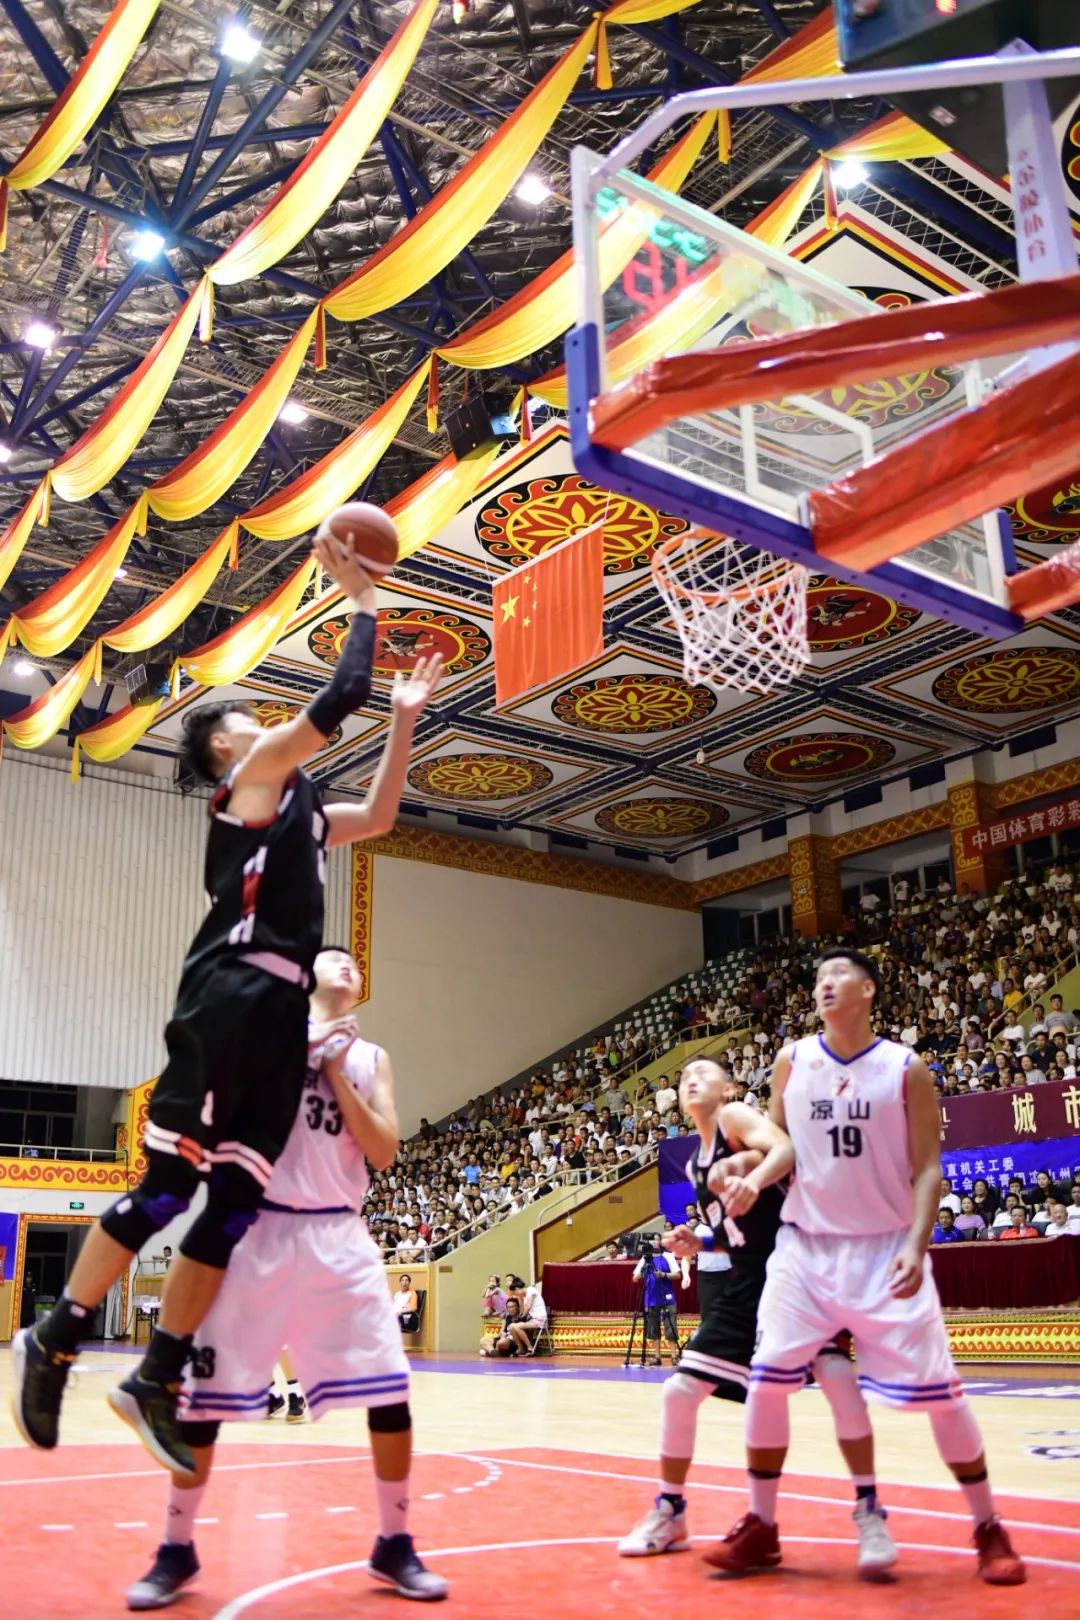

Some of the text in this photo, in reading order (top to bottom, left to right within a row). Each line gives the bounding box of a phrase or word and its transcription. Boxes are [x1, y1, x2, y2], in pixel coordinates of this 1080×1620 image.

[305, 1094, 343, 1136] 33
[810, 1098, 870, 1120] 凉山
[826, 1124, 862, 1158] 19
[940, 1157, 1014, 1178] 直机关工委
